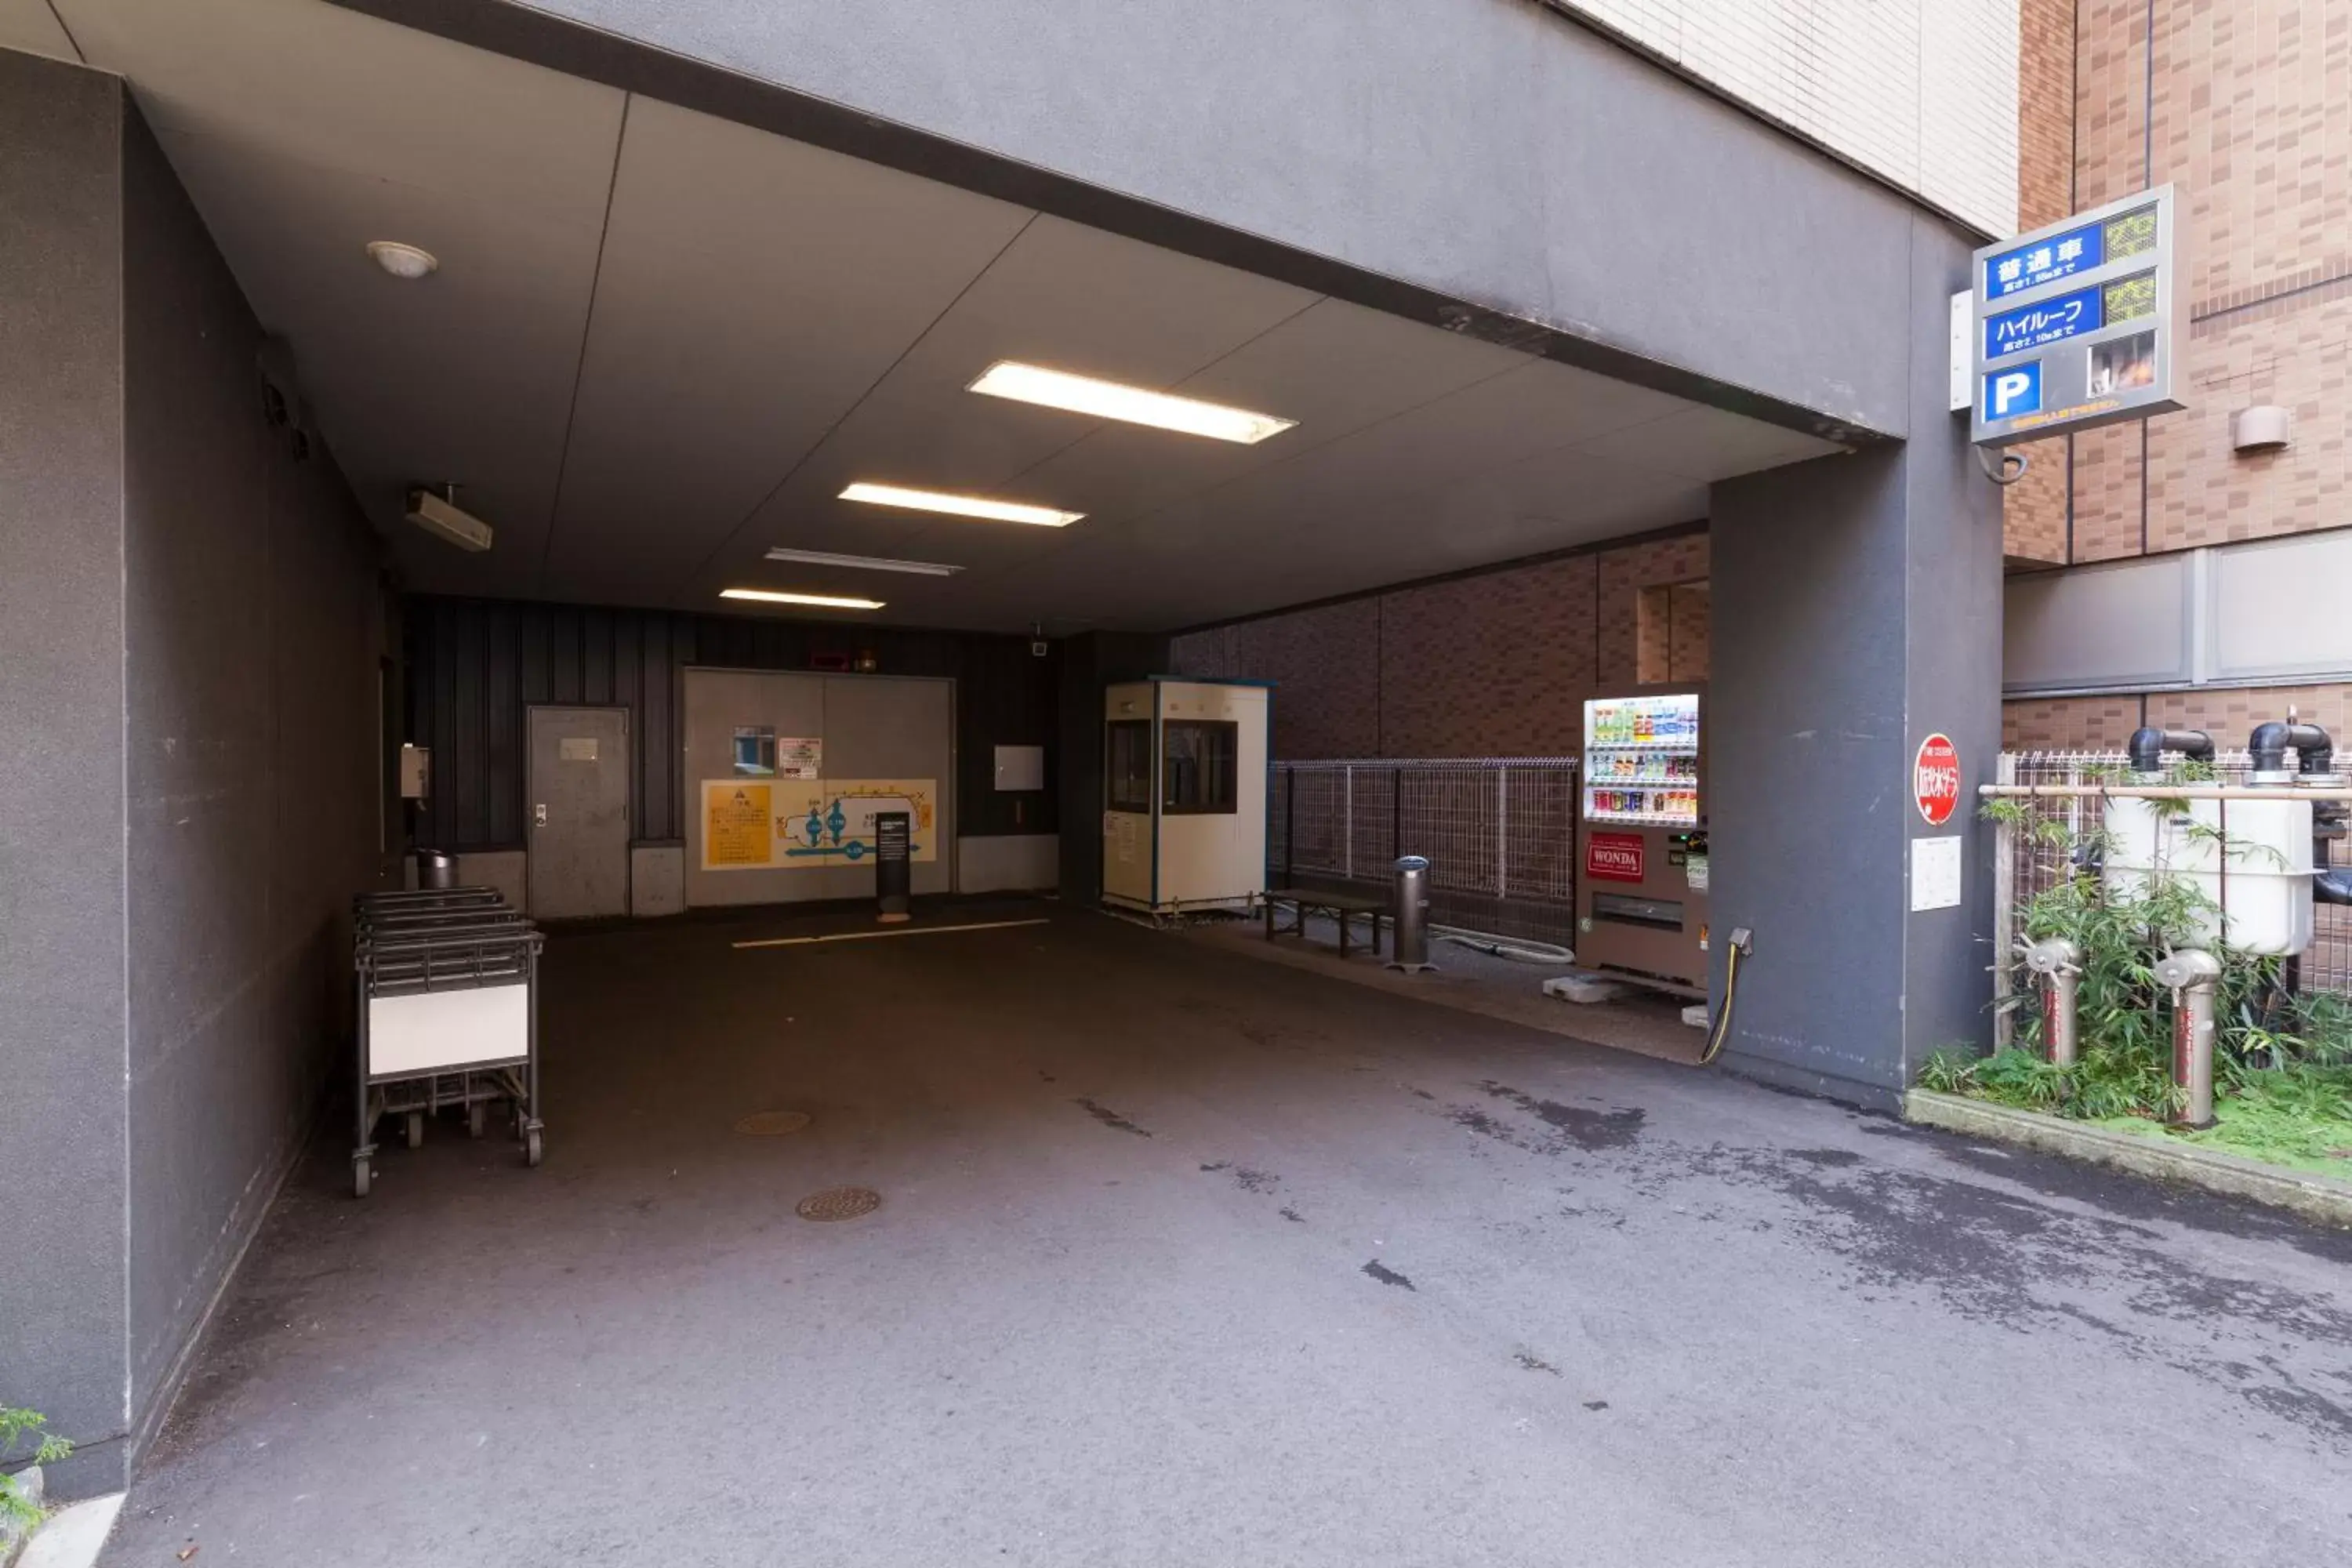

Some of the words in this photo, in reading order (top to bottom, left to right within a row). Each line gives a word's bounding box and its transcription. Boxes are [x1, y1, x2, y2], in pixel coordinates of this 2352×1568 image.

[1997, 300, 2082, 340] ハイルーフ
[1996, 372, 2030, 413] P
[1595, 850, 1636, 865] WONDA
